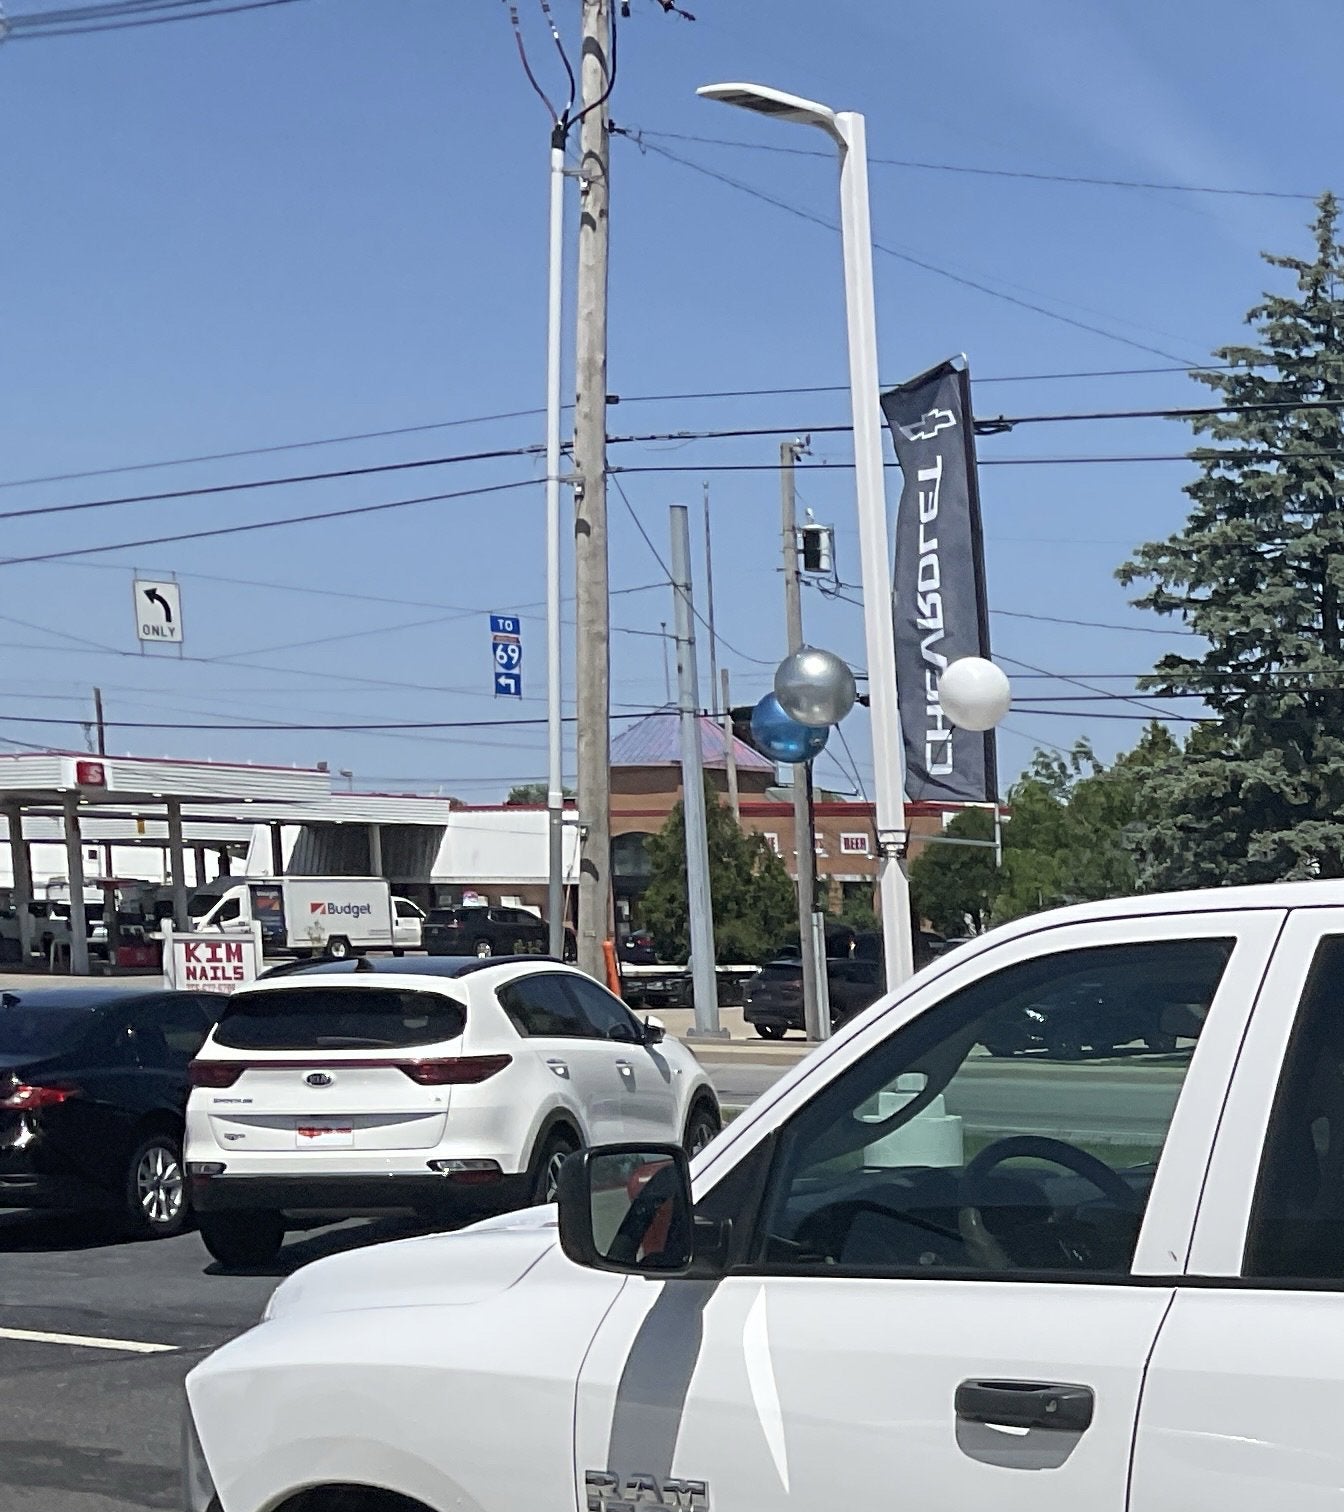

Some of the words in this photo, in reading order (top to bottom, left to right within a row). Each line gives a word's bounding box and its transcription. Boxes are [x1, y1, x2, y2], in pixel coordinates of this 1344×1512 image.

[142, 624, 175, 638] ONLY
[498, 619, 513, 632] TO
[496, 644, 520, 665] 69
[327, 902, 371, 918] Budget
[184, 942, 243, 963] KIM
[185, 965, 244, 981] NAILS
